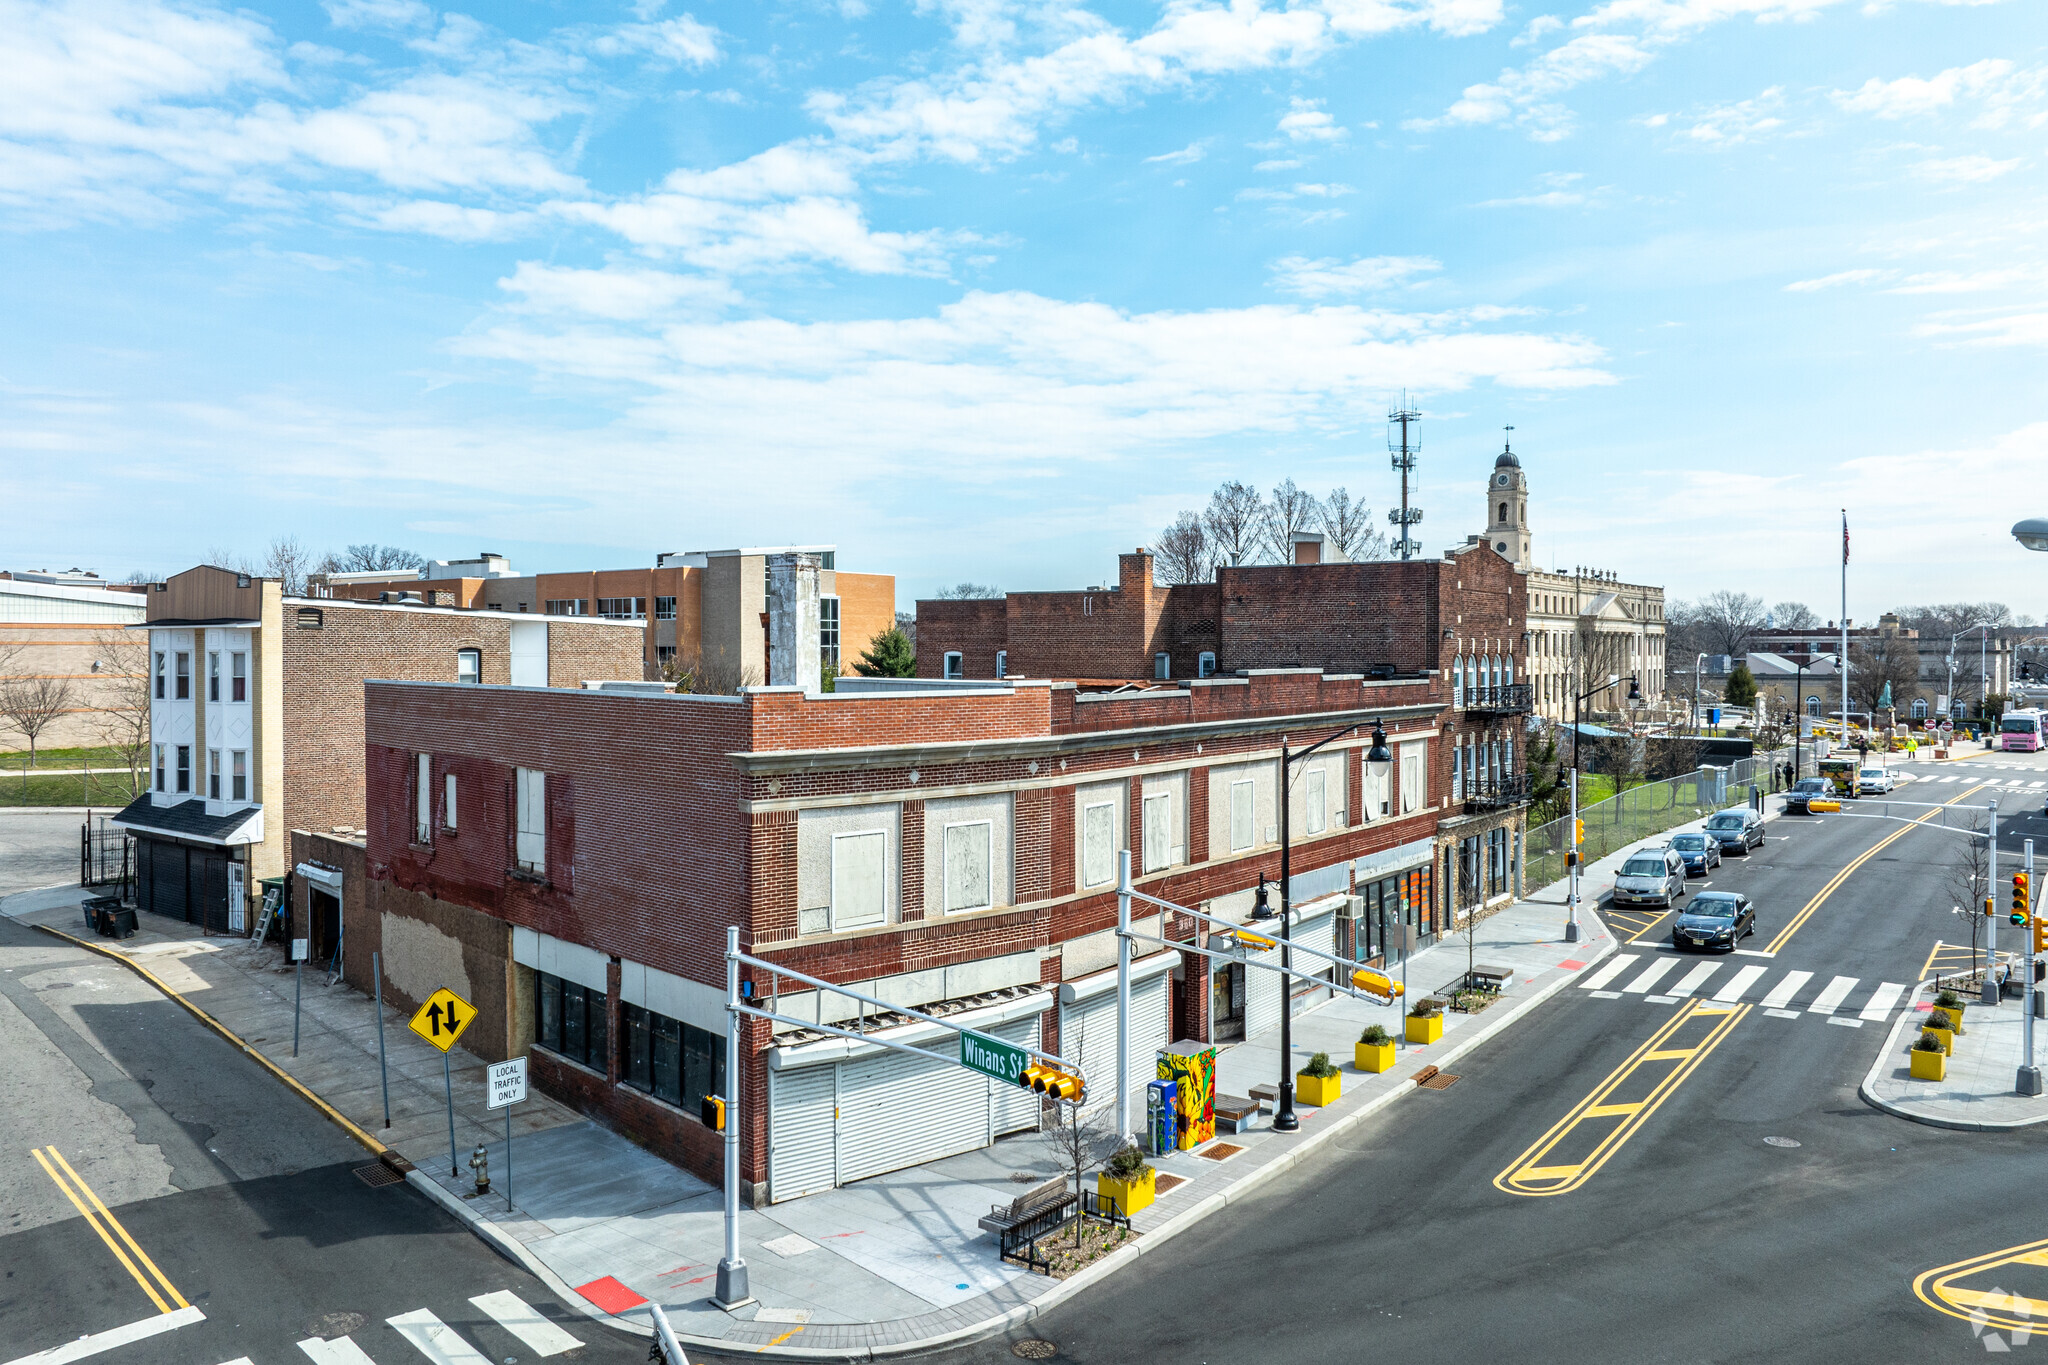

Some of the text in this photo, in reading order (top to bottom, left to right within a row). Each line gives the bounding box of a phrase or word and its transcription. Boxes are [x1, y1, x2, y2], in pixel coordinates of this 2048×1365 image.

[1992, 787, 2043, 795] STOP
[964, 1037, 1023, 1079] Winans St
[496, 1065, 519, 1078] LOCAL
[494, 1076, 521, 1090] TRAFFIC
[498, 1089, 517, 1101] ONLY
